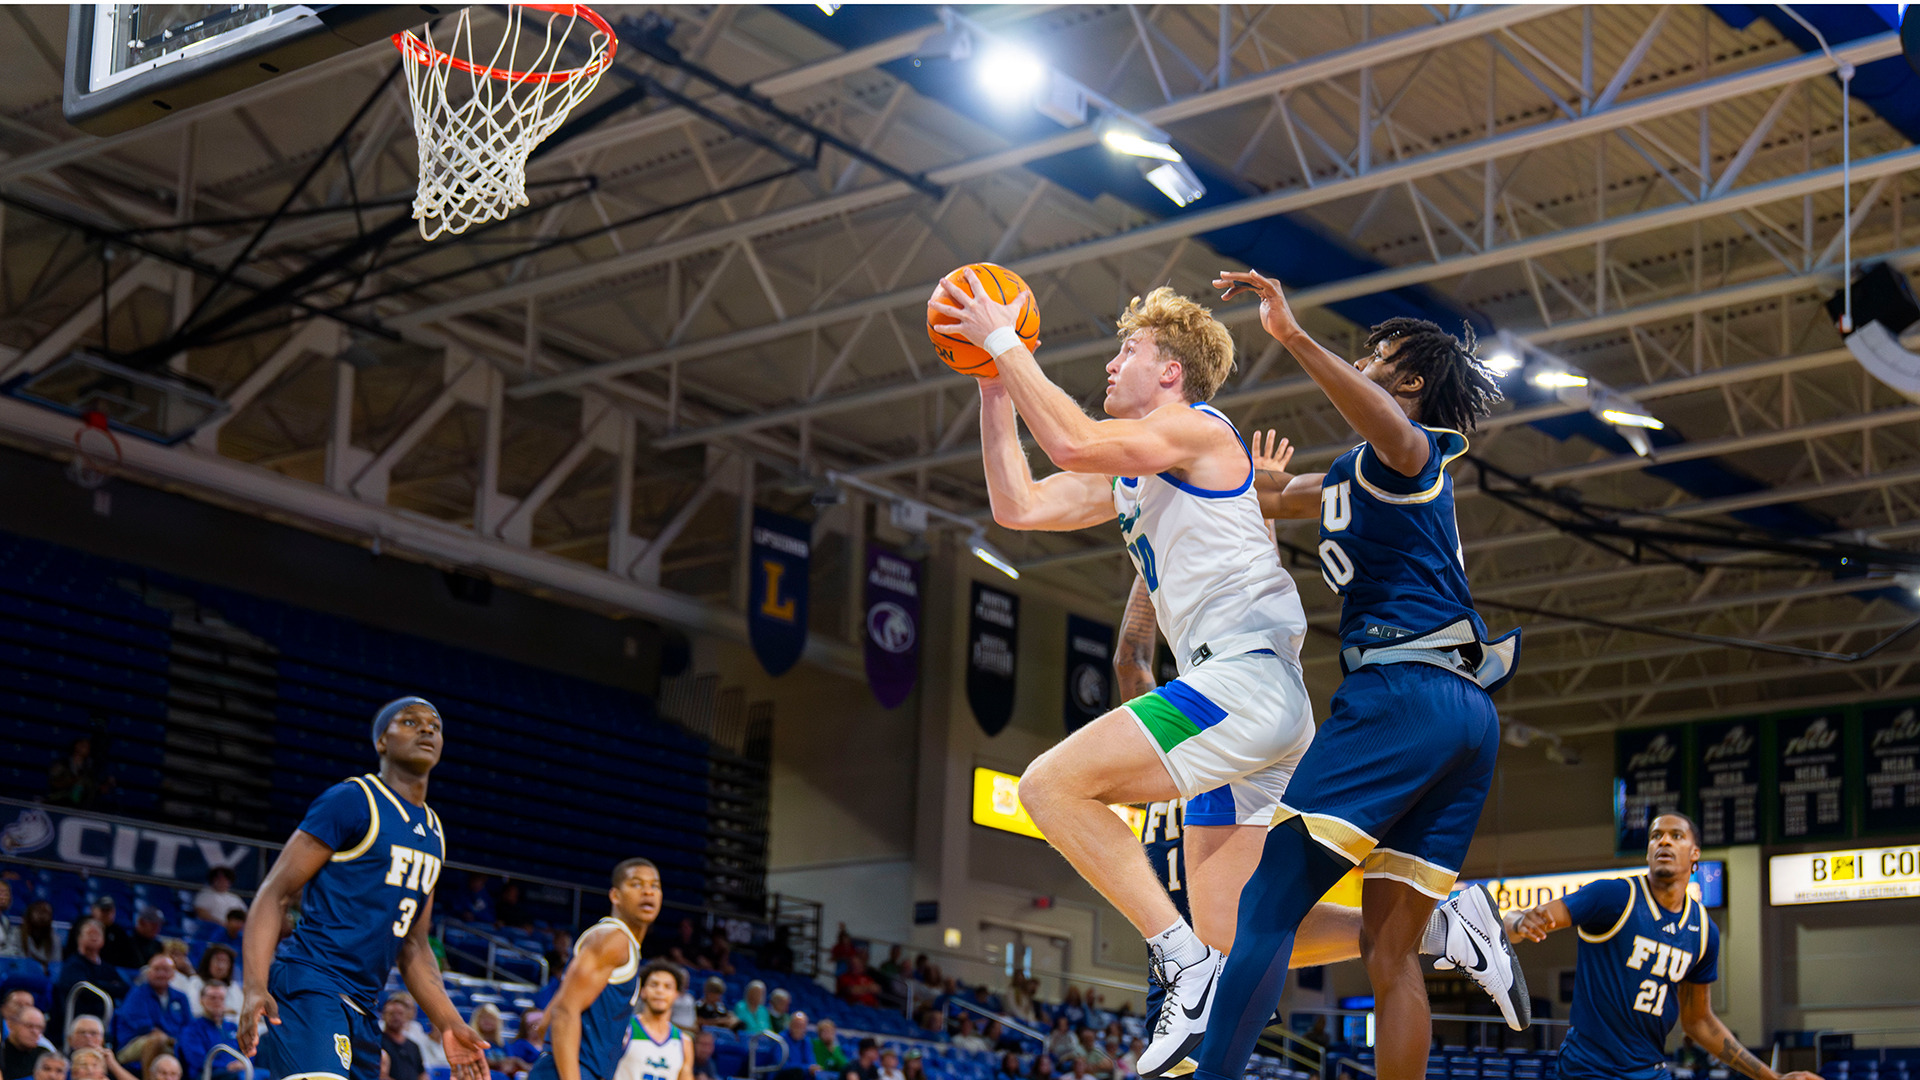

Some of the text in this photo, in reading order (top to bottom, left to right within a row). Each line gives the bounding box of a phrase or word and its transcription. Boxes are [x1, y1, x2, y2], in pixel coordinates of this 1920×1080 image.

[762, 560, 795, 622] L
[56, 814, 252, 879] CITY
[384, 843, 442, 896] FIU
[1166, 847, 1182, 892] 1
[392, 896, 418, 938] 3
[1625, 934, 1693, 984] FIU
[1632, 978, 1669, 1017] 21
